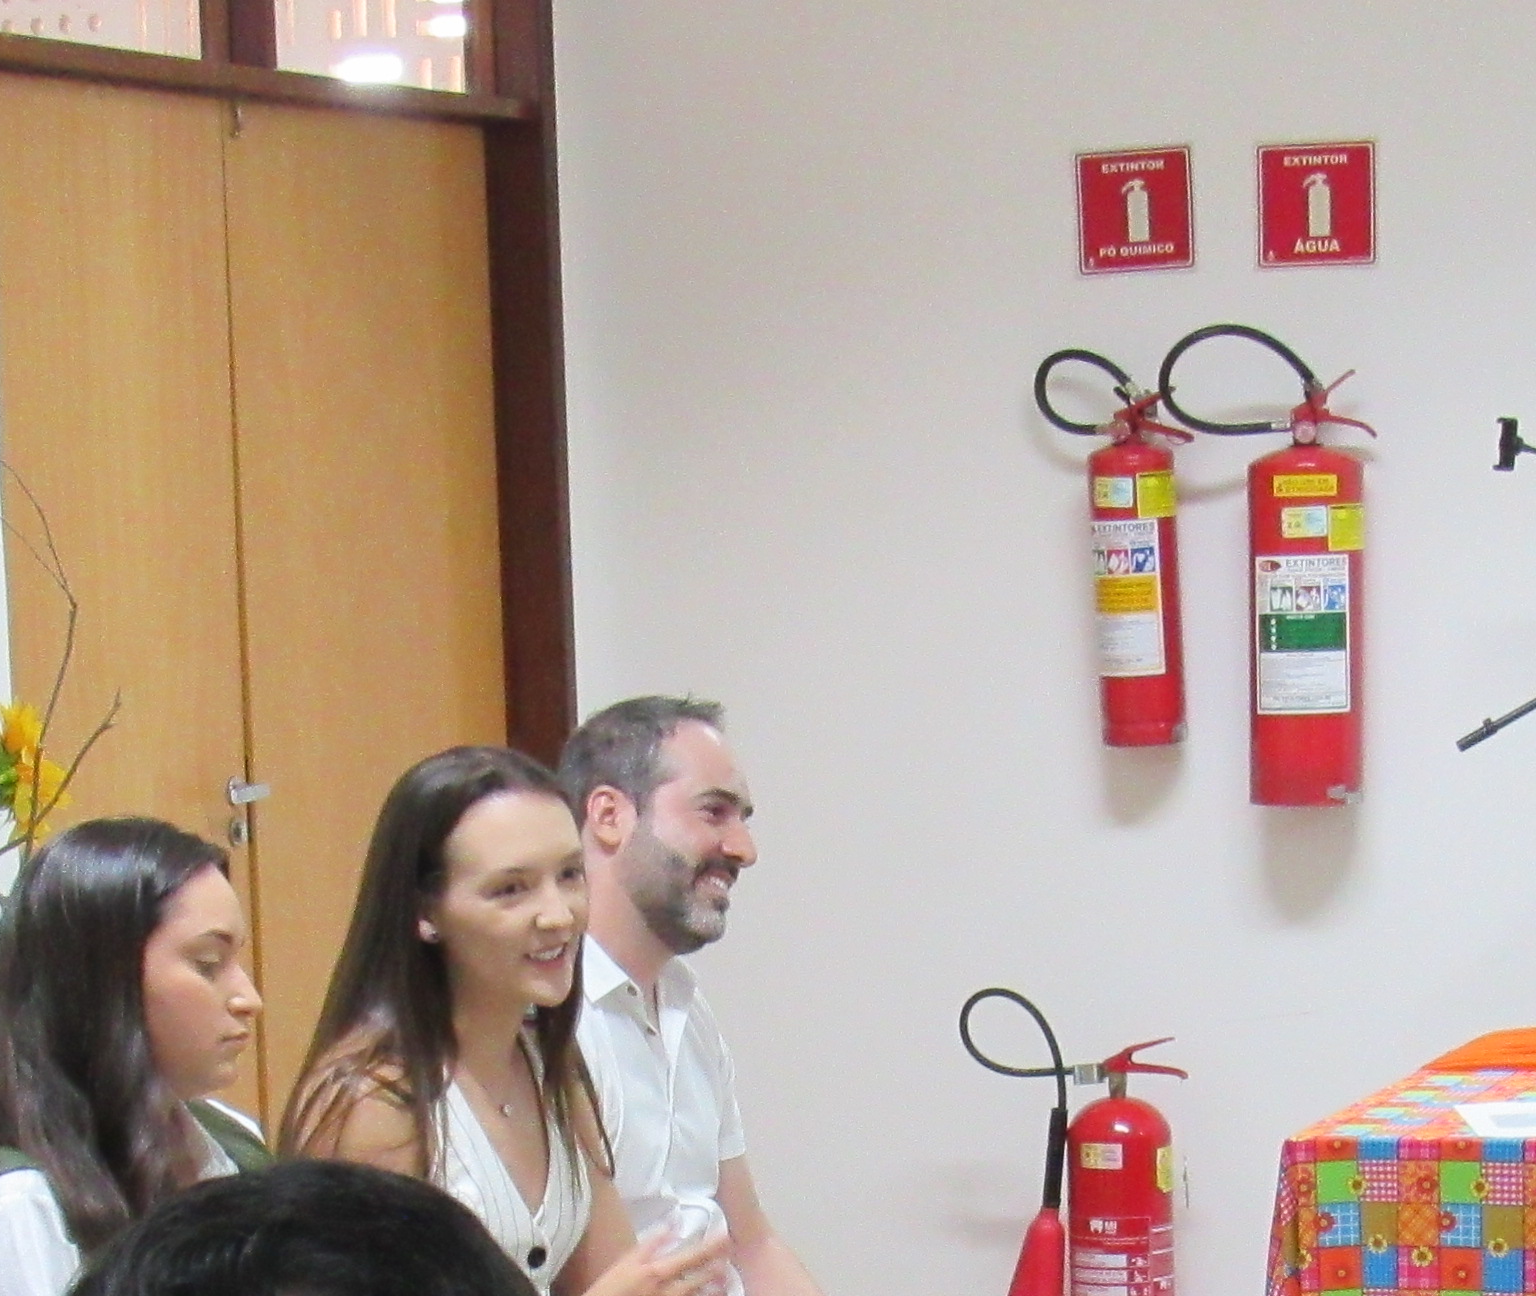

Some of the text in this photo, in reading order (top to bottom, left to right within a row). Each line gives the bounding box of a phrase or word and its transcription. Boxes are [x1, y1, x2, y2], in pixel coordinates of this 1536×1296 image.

[1101, 159, 1165, 174] EXTINTOR
[1283, 154, 1348, 168] EXTINTOR
[1293, 238, 1340, 254] ÁGUA
